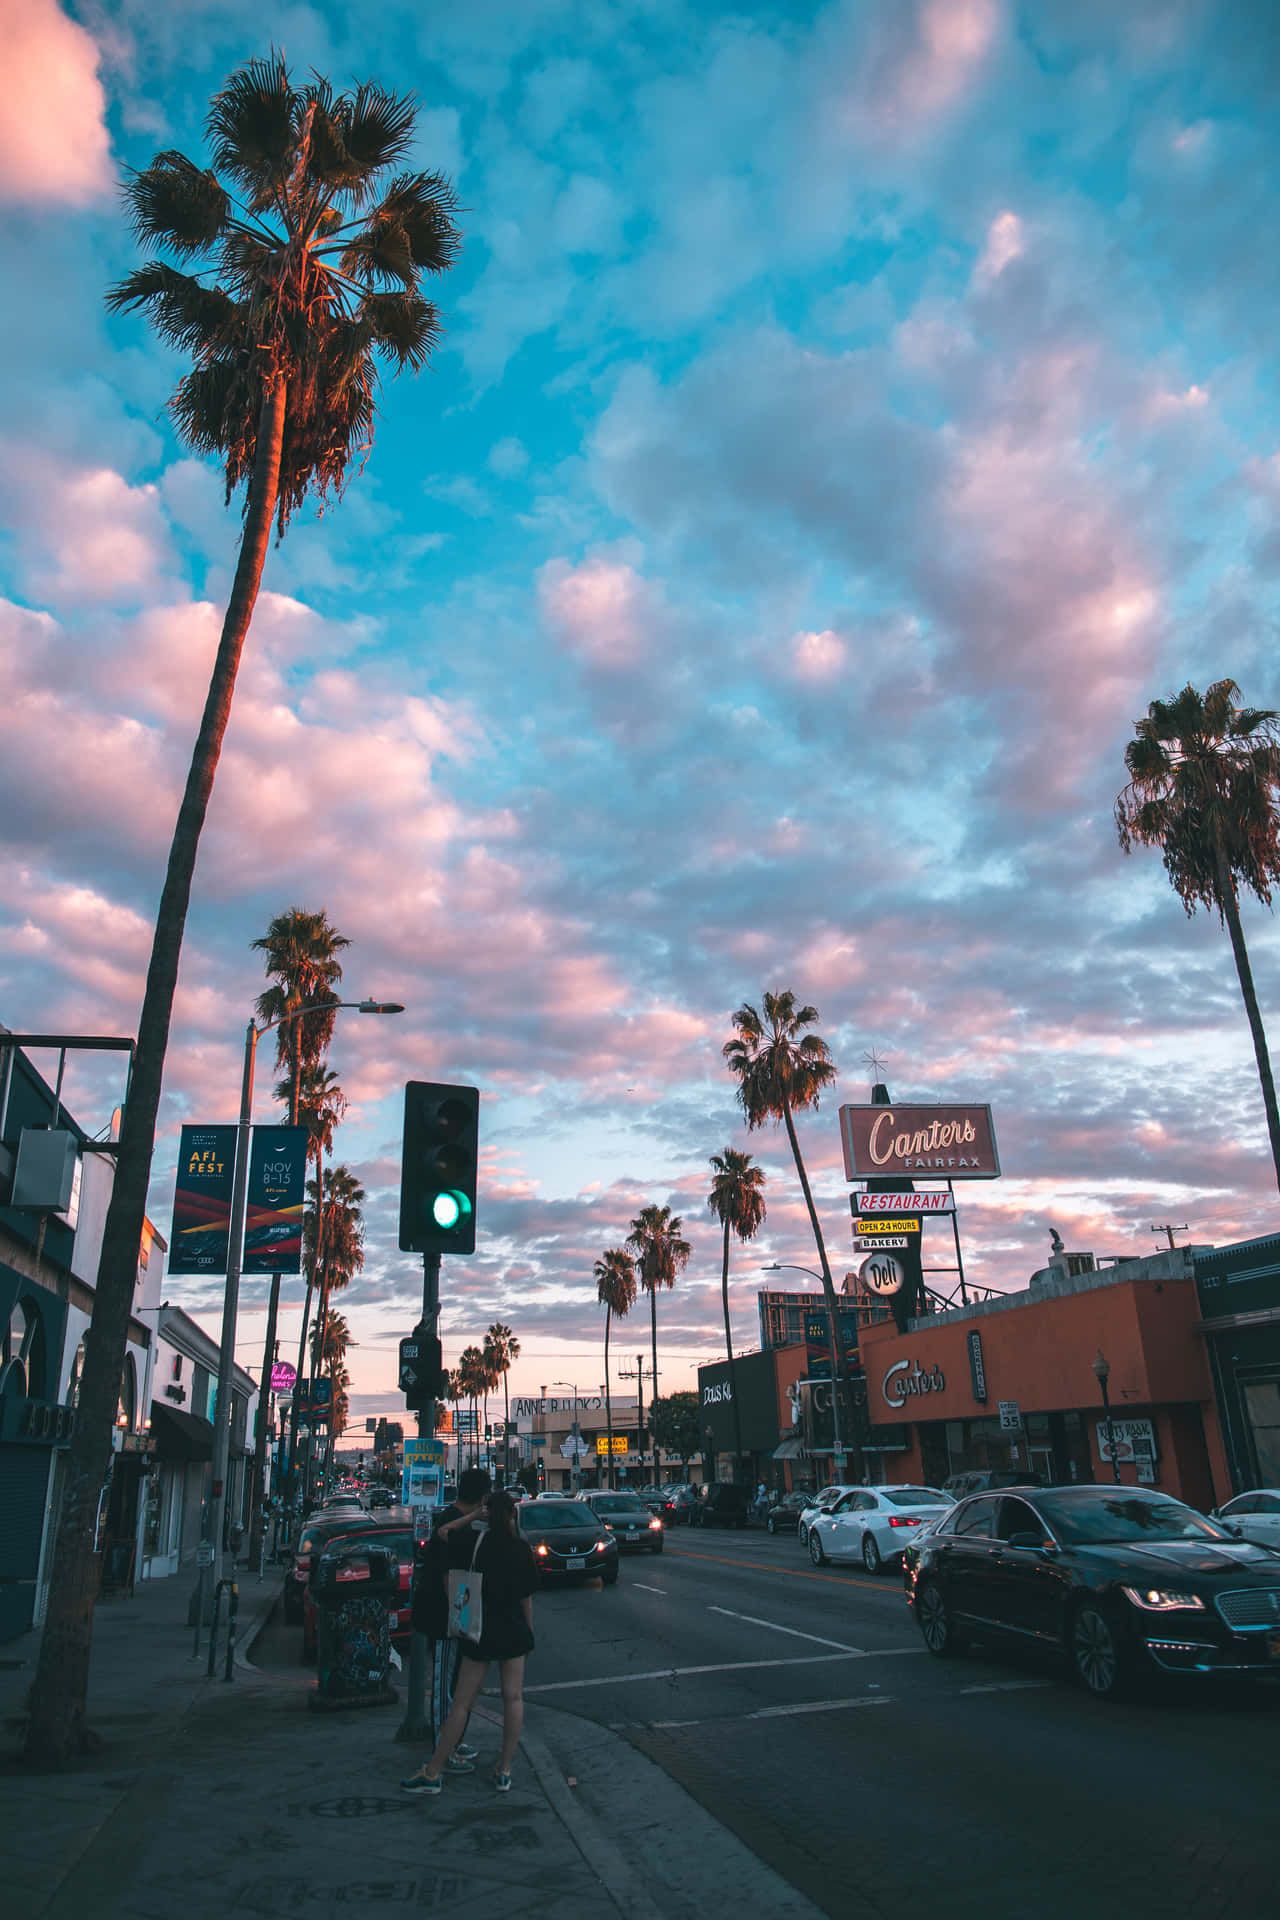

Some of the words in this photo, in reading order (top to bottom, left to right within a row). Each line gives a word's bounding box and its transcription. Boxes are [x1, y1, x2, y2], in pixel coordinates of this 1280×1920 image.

[190, 1151, 217, 1162] AFI
[188, 1162, 225, 1174] FEST
[263, 1162, 292, 1173] NOV
[905, 1157, 980, 1169] FAIRFAX
[860, 1194, 952, 1210] RESTAURANT
[859, 1222, 879, 1231] OPEN
[879, 1222, 892, 1231] 24
[893, 1221, 917, 1231] HOURS
[863, 1238, 905, 1248] BAKERY
[870, 1257, 898, 1289] Deli
[882, 1359, 945, 1408] Canter's
[1003, 1416, 1019, 1428] 35
